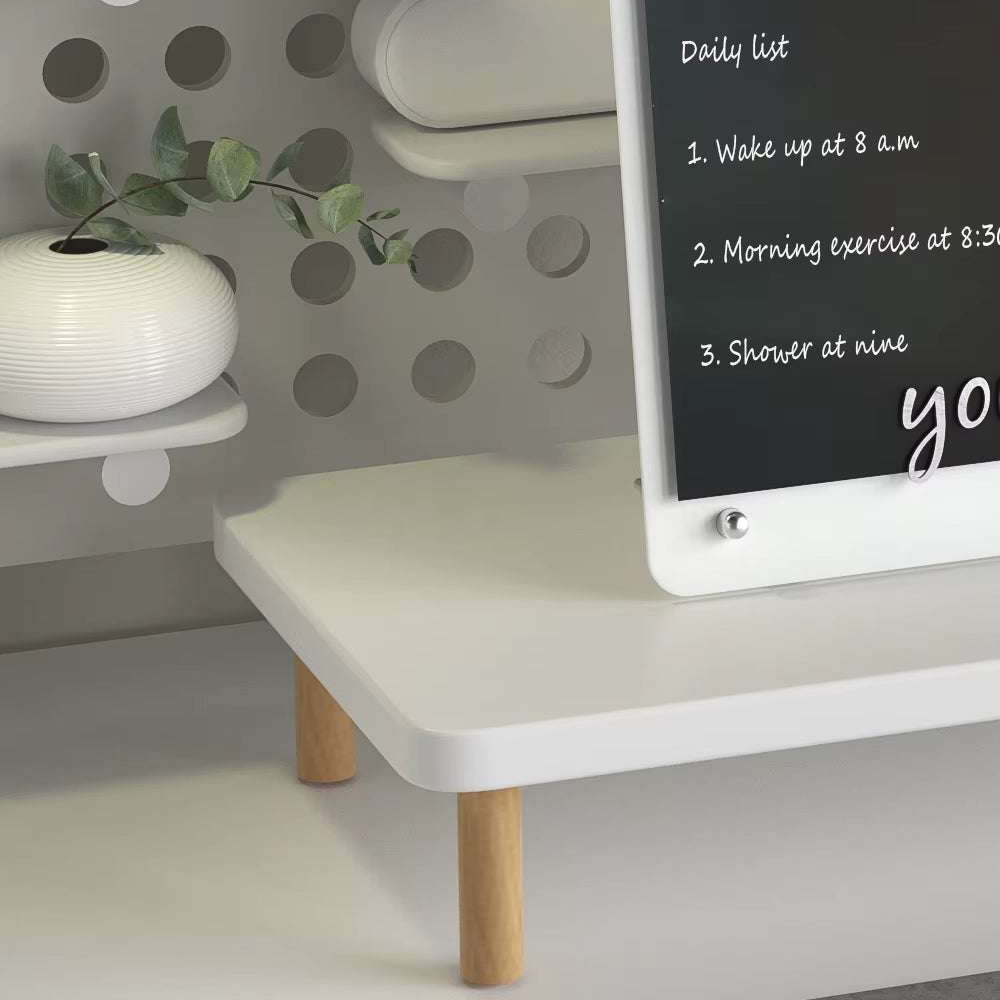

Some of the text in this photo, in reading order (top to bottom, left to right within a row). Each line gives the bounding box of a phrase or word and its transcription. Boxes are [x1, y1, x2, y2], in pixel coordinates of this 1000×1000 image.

[681, 32, 790, 69] Daily list
[687, 131, 920, 166] 1. Wake up at 8 a.m
[693, 242, 714, 267] 2.
[723, 233, 822, 265] Morning
[830, 226, 920, 257] exercise
[927, 227, 951, 249] at
[700, 330, 909, 367] 3. Shower at nine
